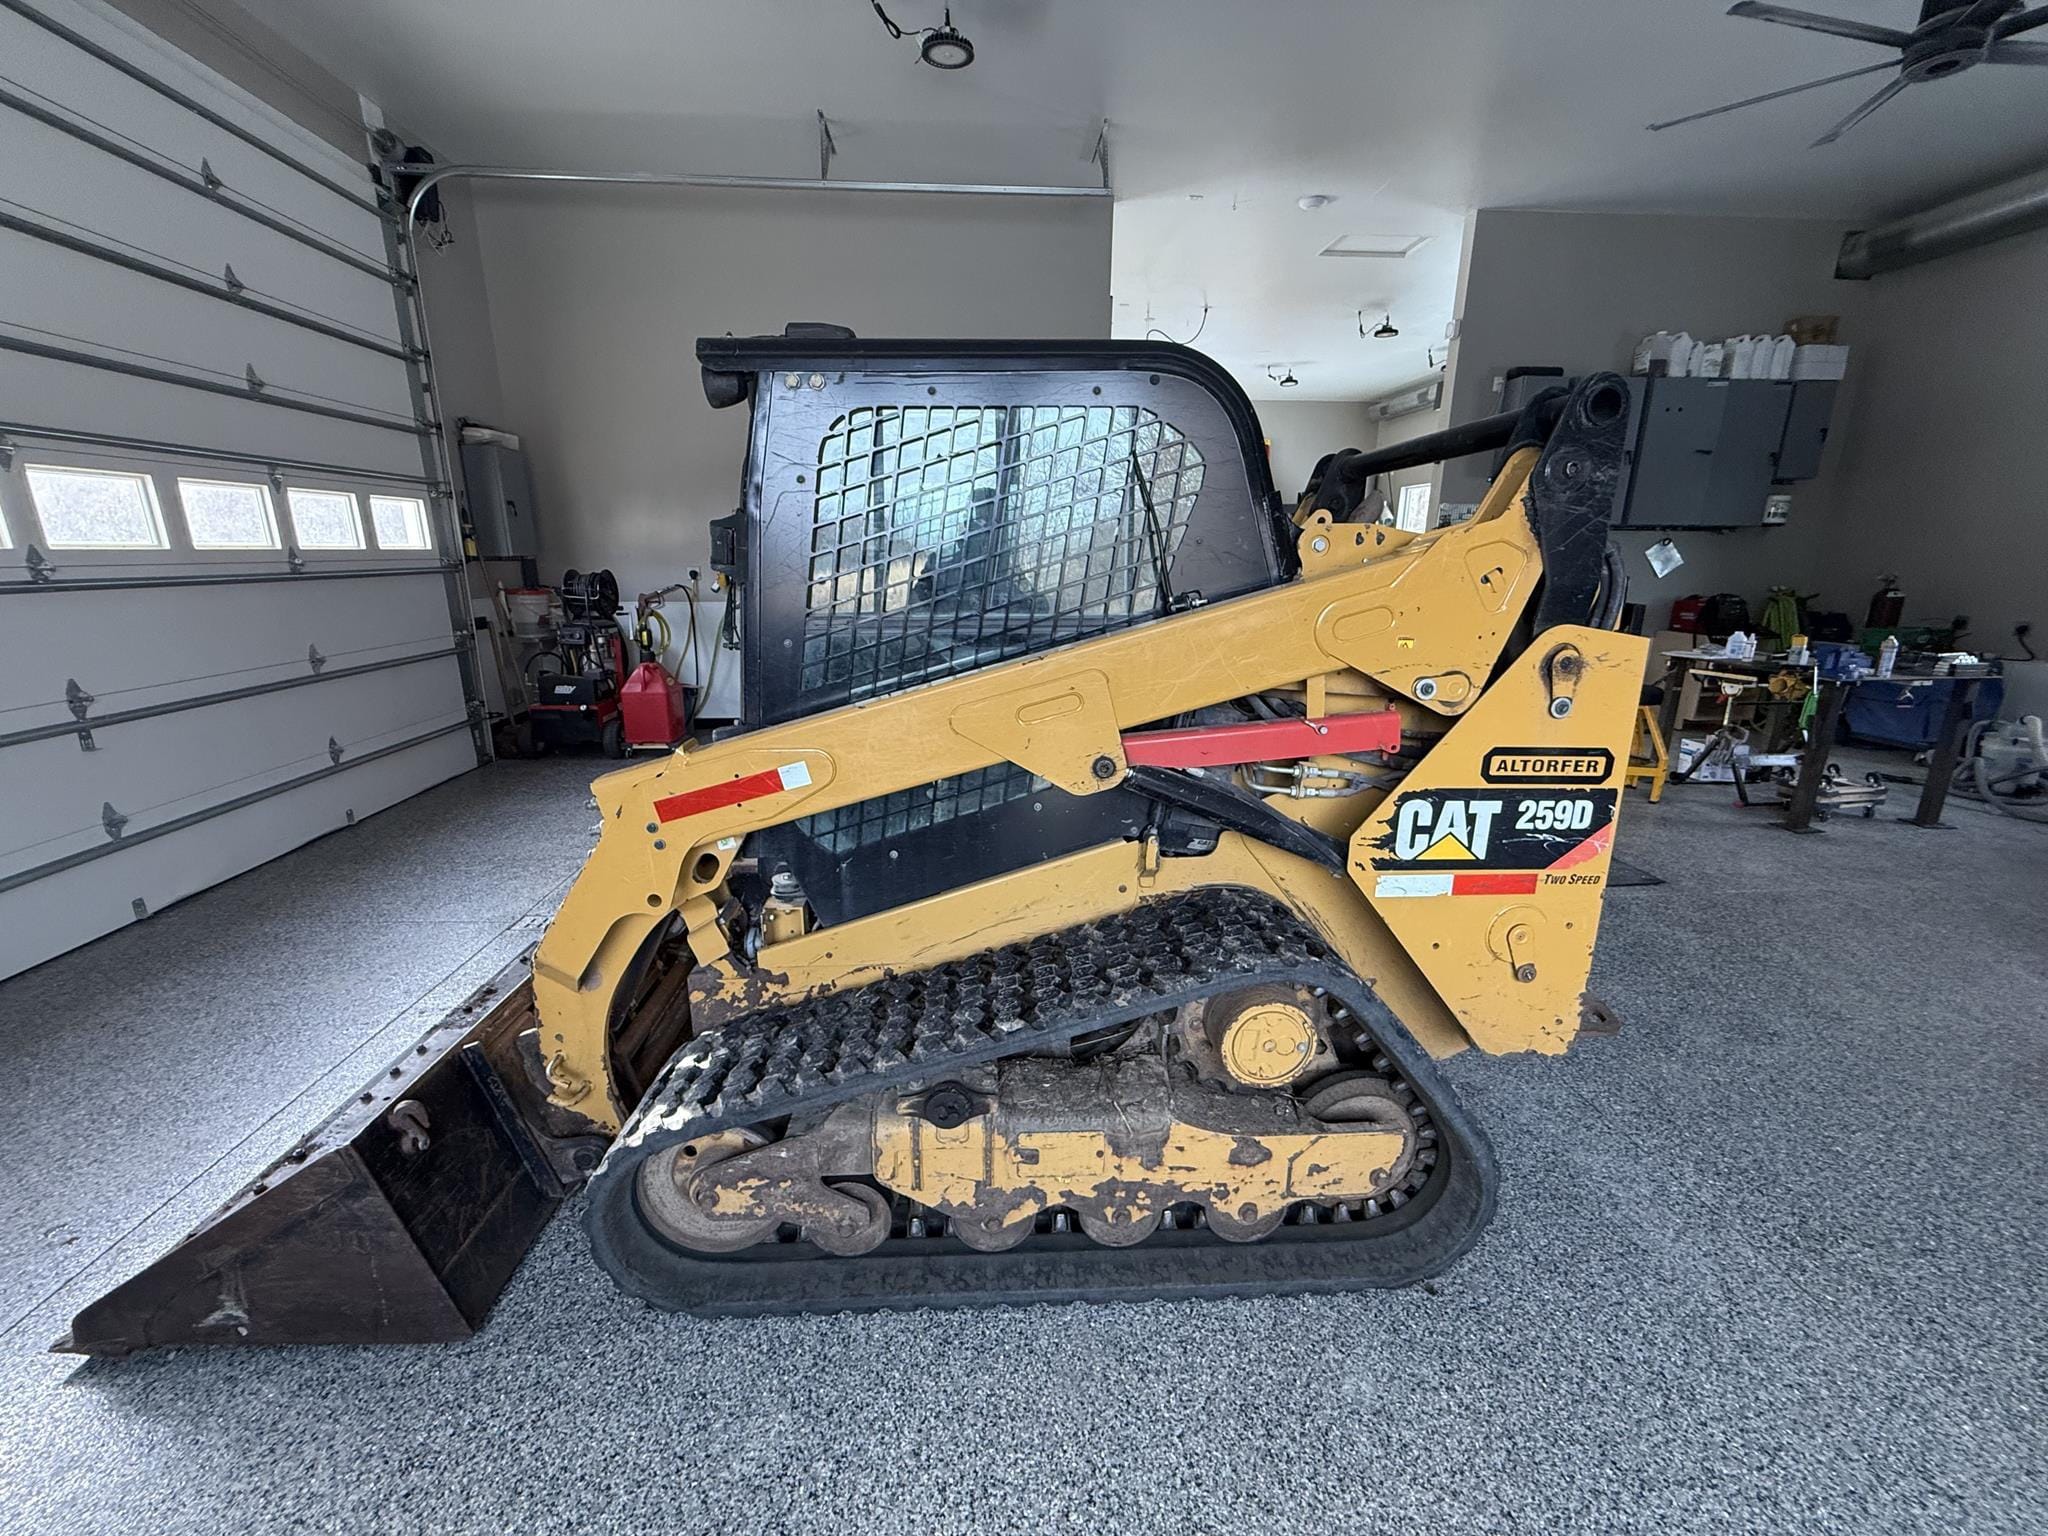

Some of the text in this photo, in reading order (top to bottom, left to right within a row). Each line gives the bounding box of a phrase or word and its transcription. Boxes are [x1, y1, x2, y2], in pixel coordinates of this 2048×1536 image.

[1496, 759, 1599, 773] ALTORFER
[1395, 799, 1594, 860] CAT 259D
